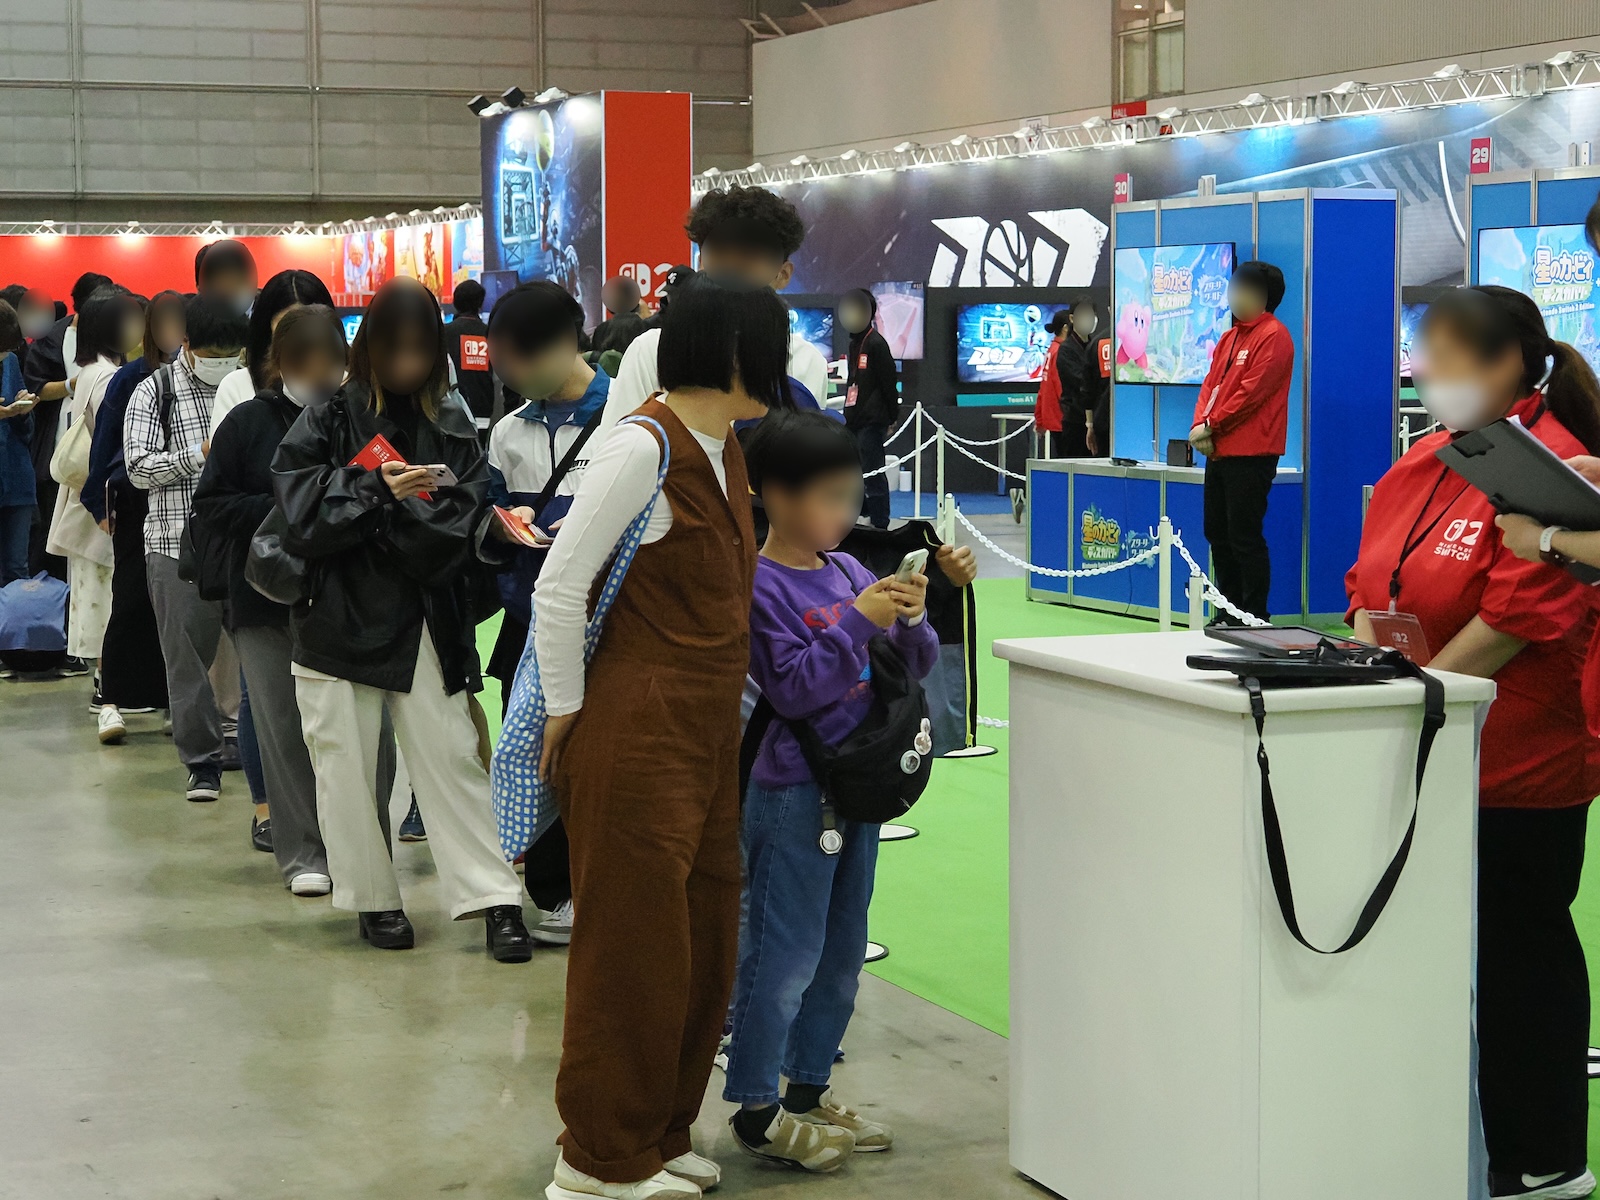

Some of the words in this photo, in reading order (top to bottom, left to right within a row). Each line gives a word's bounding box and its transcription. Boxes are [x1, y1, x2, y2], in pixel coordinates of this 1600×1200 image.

[1113, 109, 1127, 118] HALL
[1472, 147, 1489, 164] 29
[1115, 182, 1127, 195] 30
[1535, 248, 1593, 284] 星のカービィ
[1153, 265, 1192, 293] 星のカービィ
[478, 341, 488, 356] 2
[1082, 513, 1120, 544] 星のカービィ
[1461, 521, 1483, 545] 2
[1087, 545, 1117, 559] ディスカバリー
[1433, 546, 1471, 561] SWITCH
